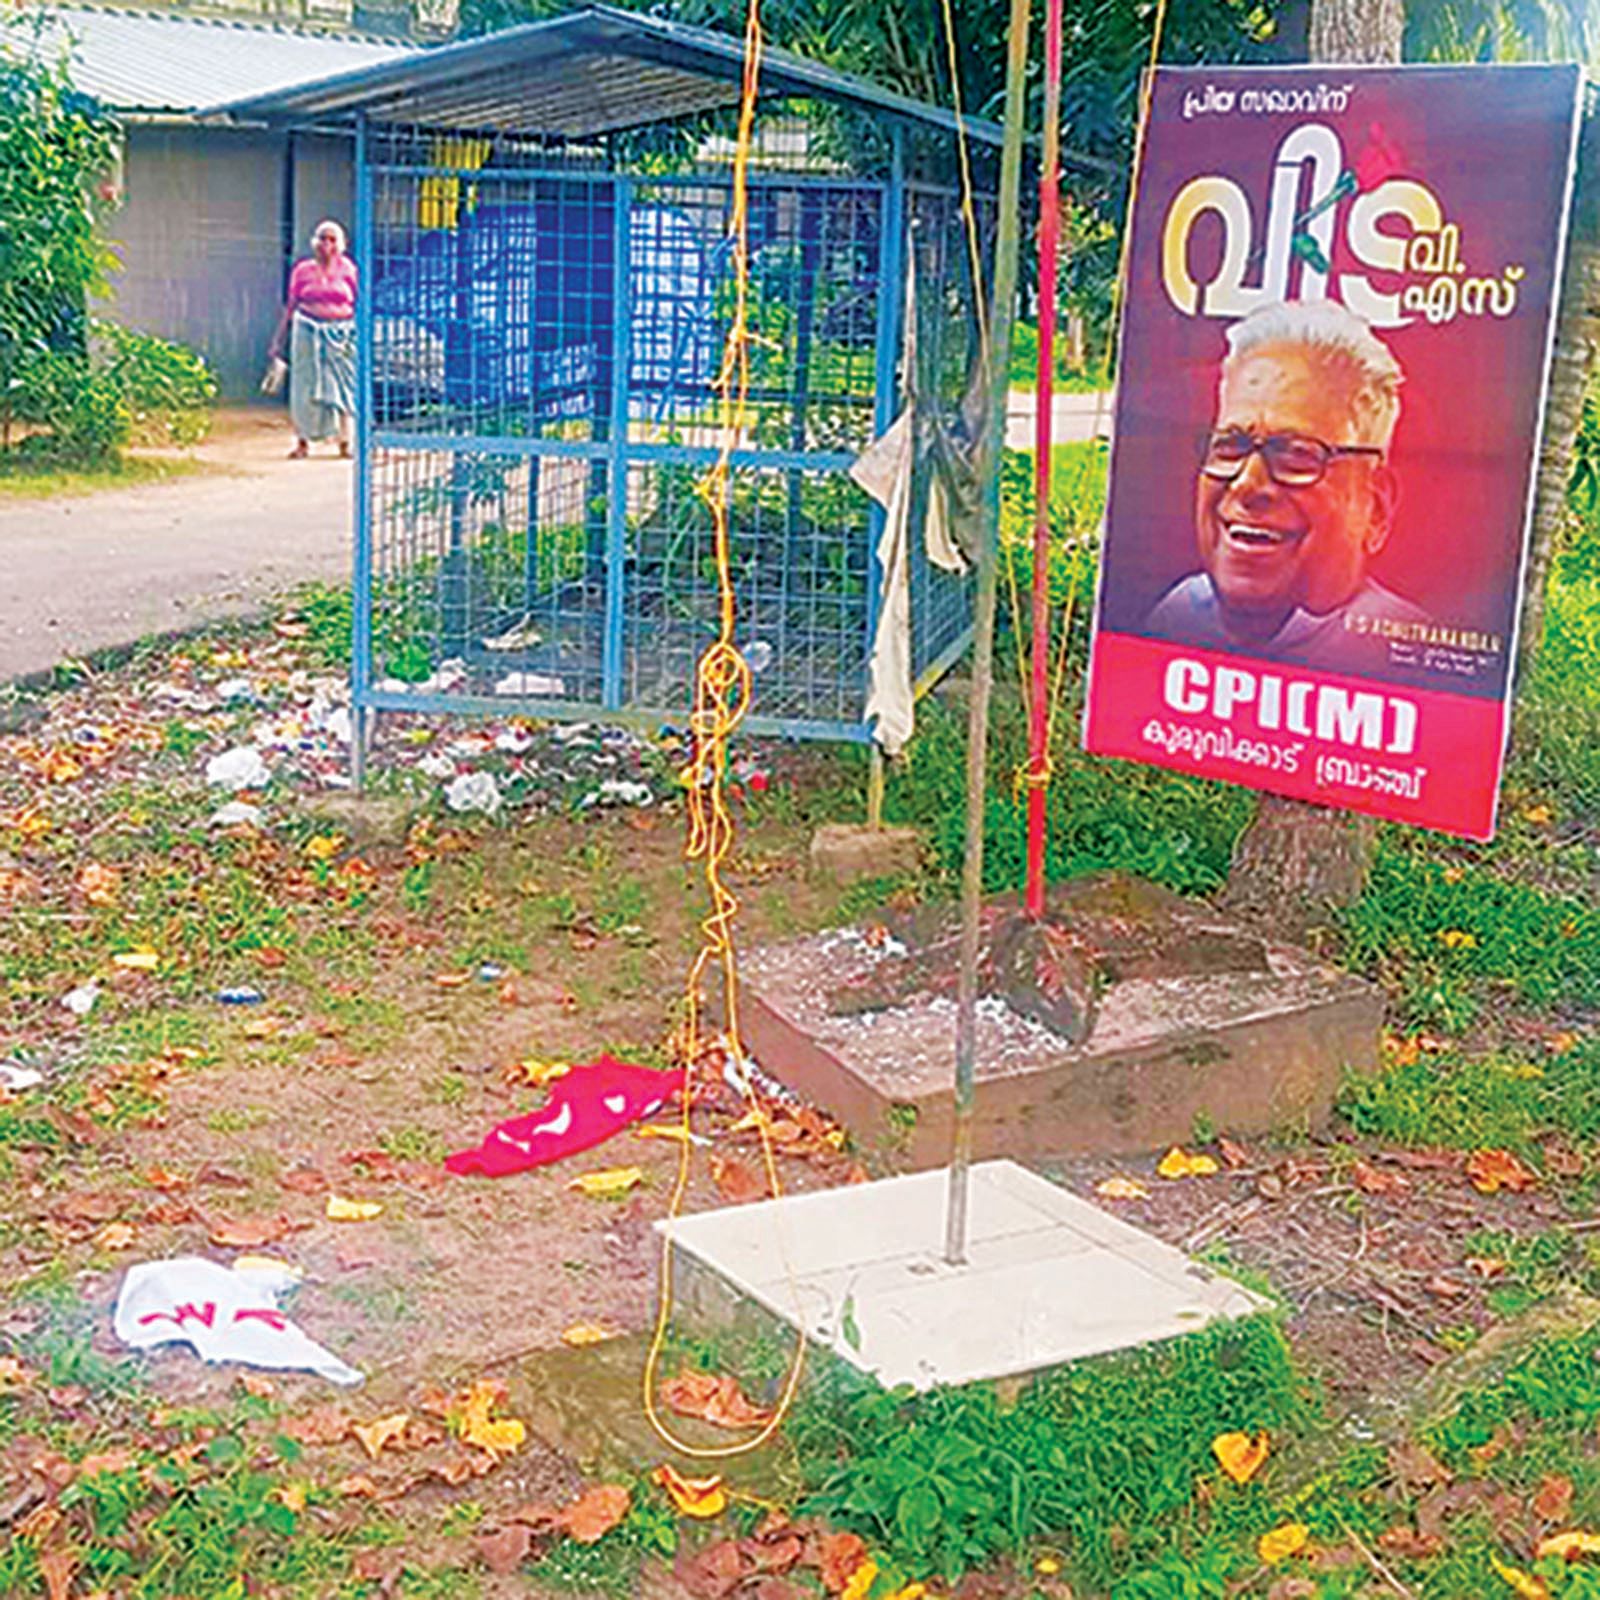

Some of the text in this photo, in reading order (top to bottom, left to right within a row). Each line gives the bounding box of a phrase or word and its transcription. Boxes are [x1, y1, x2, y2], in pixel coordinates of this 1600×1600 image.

[1183, 84, 1355, 118] പ്രിയ സഖാവിന്
[1162, 123, 1443, 328] വിട
[1409, 223, 1467, 274] വി.
[1403, 265, 1525, 324] എസ്
[1163, 658, 1420, 754] CPI(M)
[1142, 719, 1305, 774] കുരുവിക്കാട്
